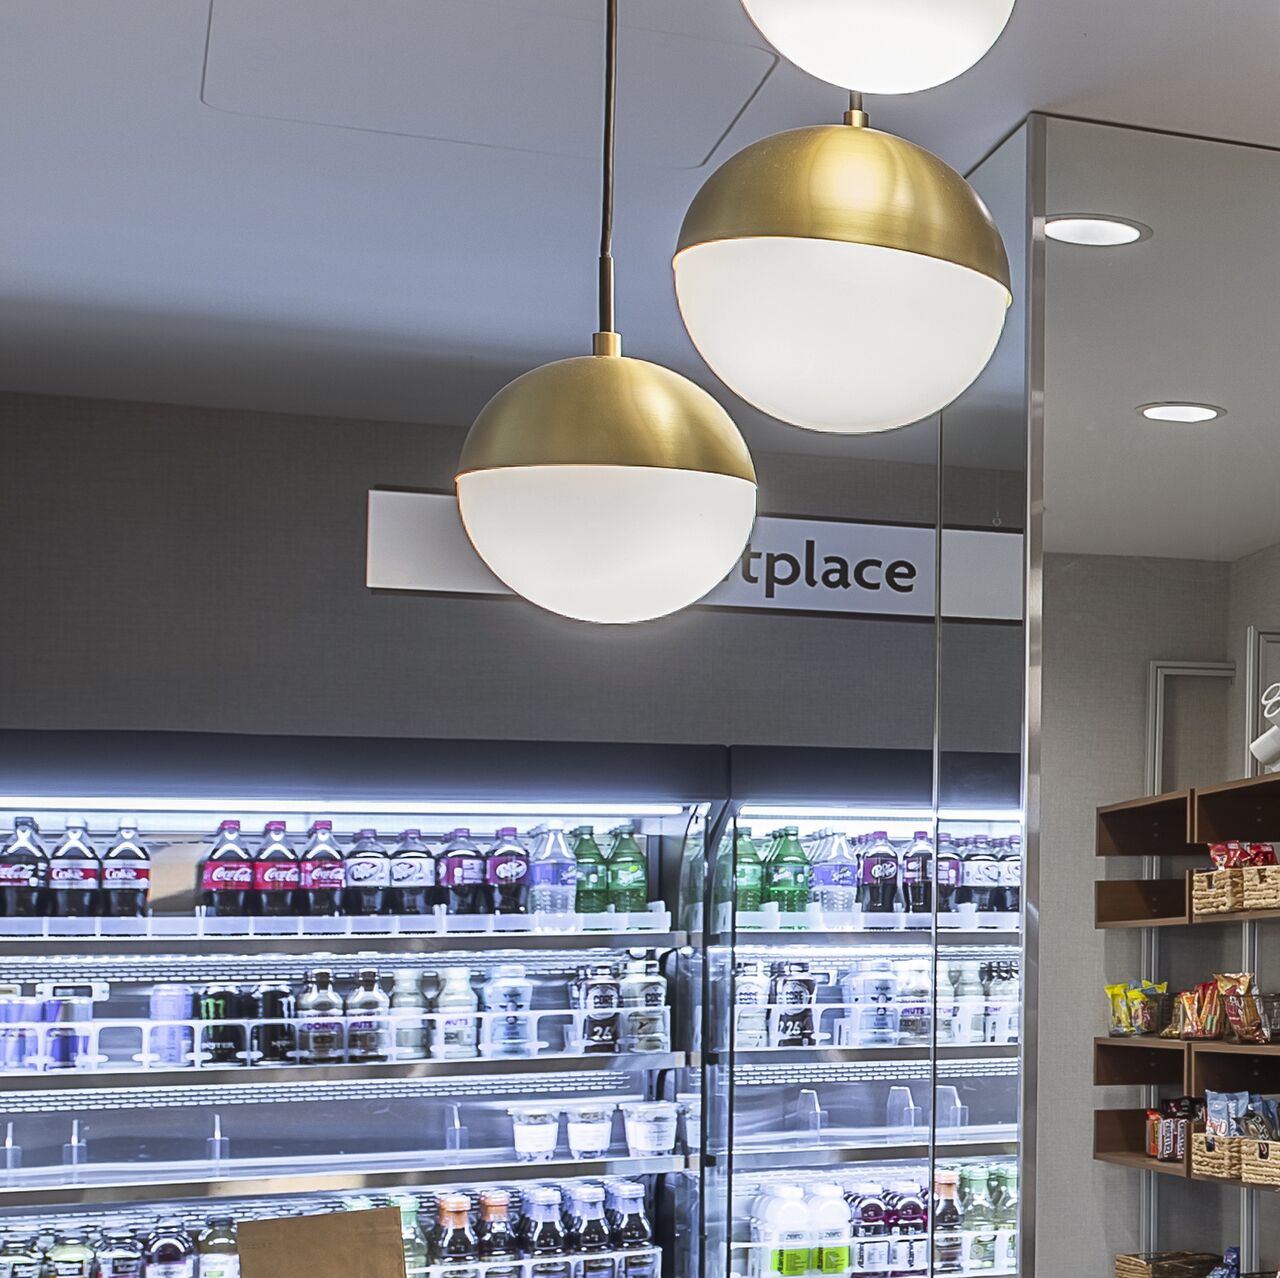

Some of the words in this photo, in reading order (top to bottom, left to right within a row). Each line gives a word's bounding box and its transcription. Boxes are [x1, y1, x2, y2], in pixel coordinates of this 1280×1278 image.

[725, 539, 918, 598] tplace
[52, 869, 84, 880] Coke
[105, 869, 137, 880] Coke
